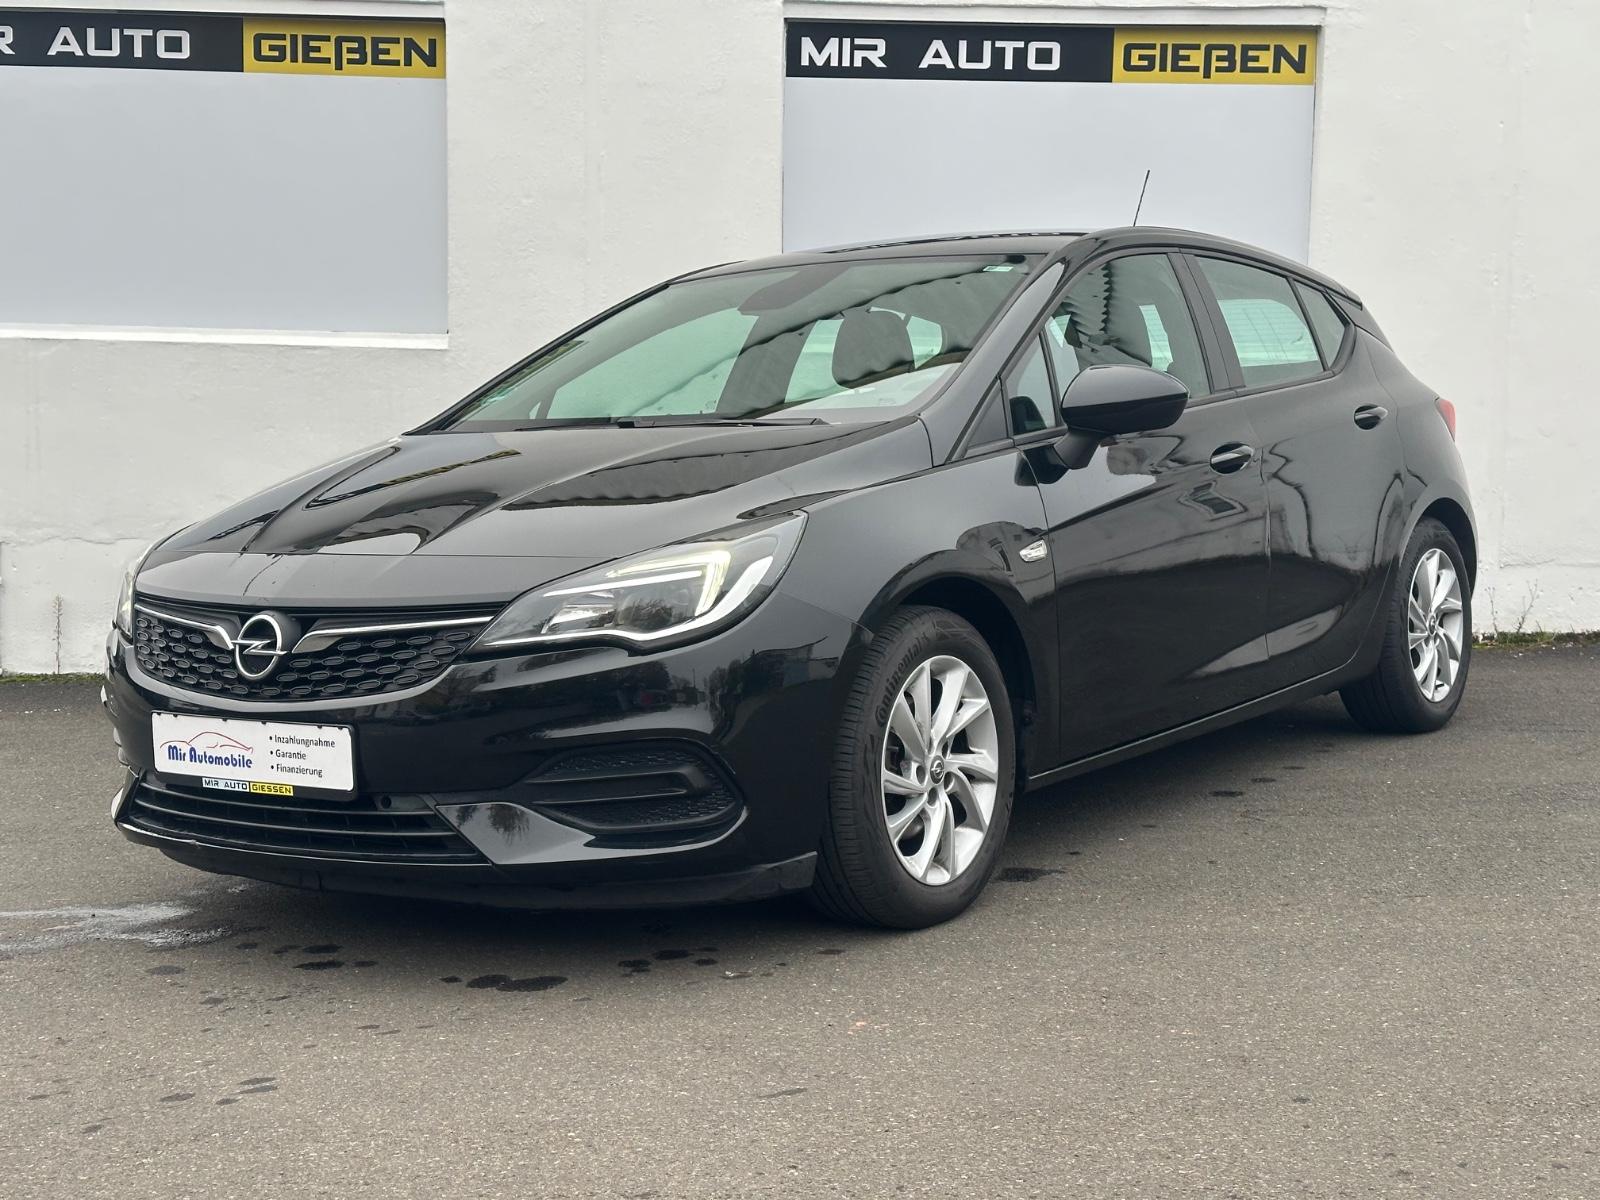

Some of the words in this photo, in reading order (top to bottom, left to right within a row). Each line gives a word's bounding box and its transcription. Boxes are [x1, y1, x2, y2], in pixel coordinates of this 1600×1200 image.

[47, 26, 191, 59] AUTO
[800, 36, 887, 69] MIR
[918, 39, 1061, 72] AUTO
[274, 734, 336, 749] Inzahlungnahme
[167, 744, 187, 762] Mir
[189, 746, 253, 769] Automobile
[275, 749, 307, 761] Garantie
[276, 764, 323, 778] Finanzierung
[204, 779, 219, 787] MIR
[224, 782, 248, 791] AUTO
[251, 783, 292, 795] GIESSEN
